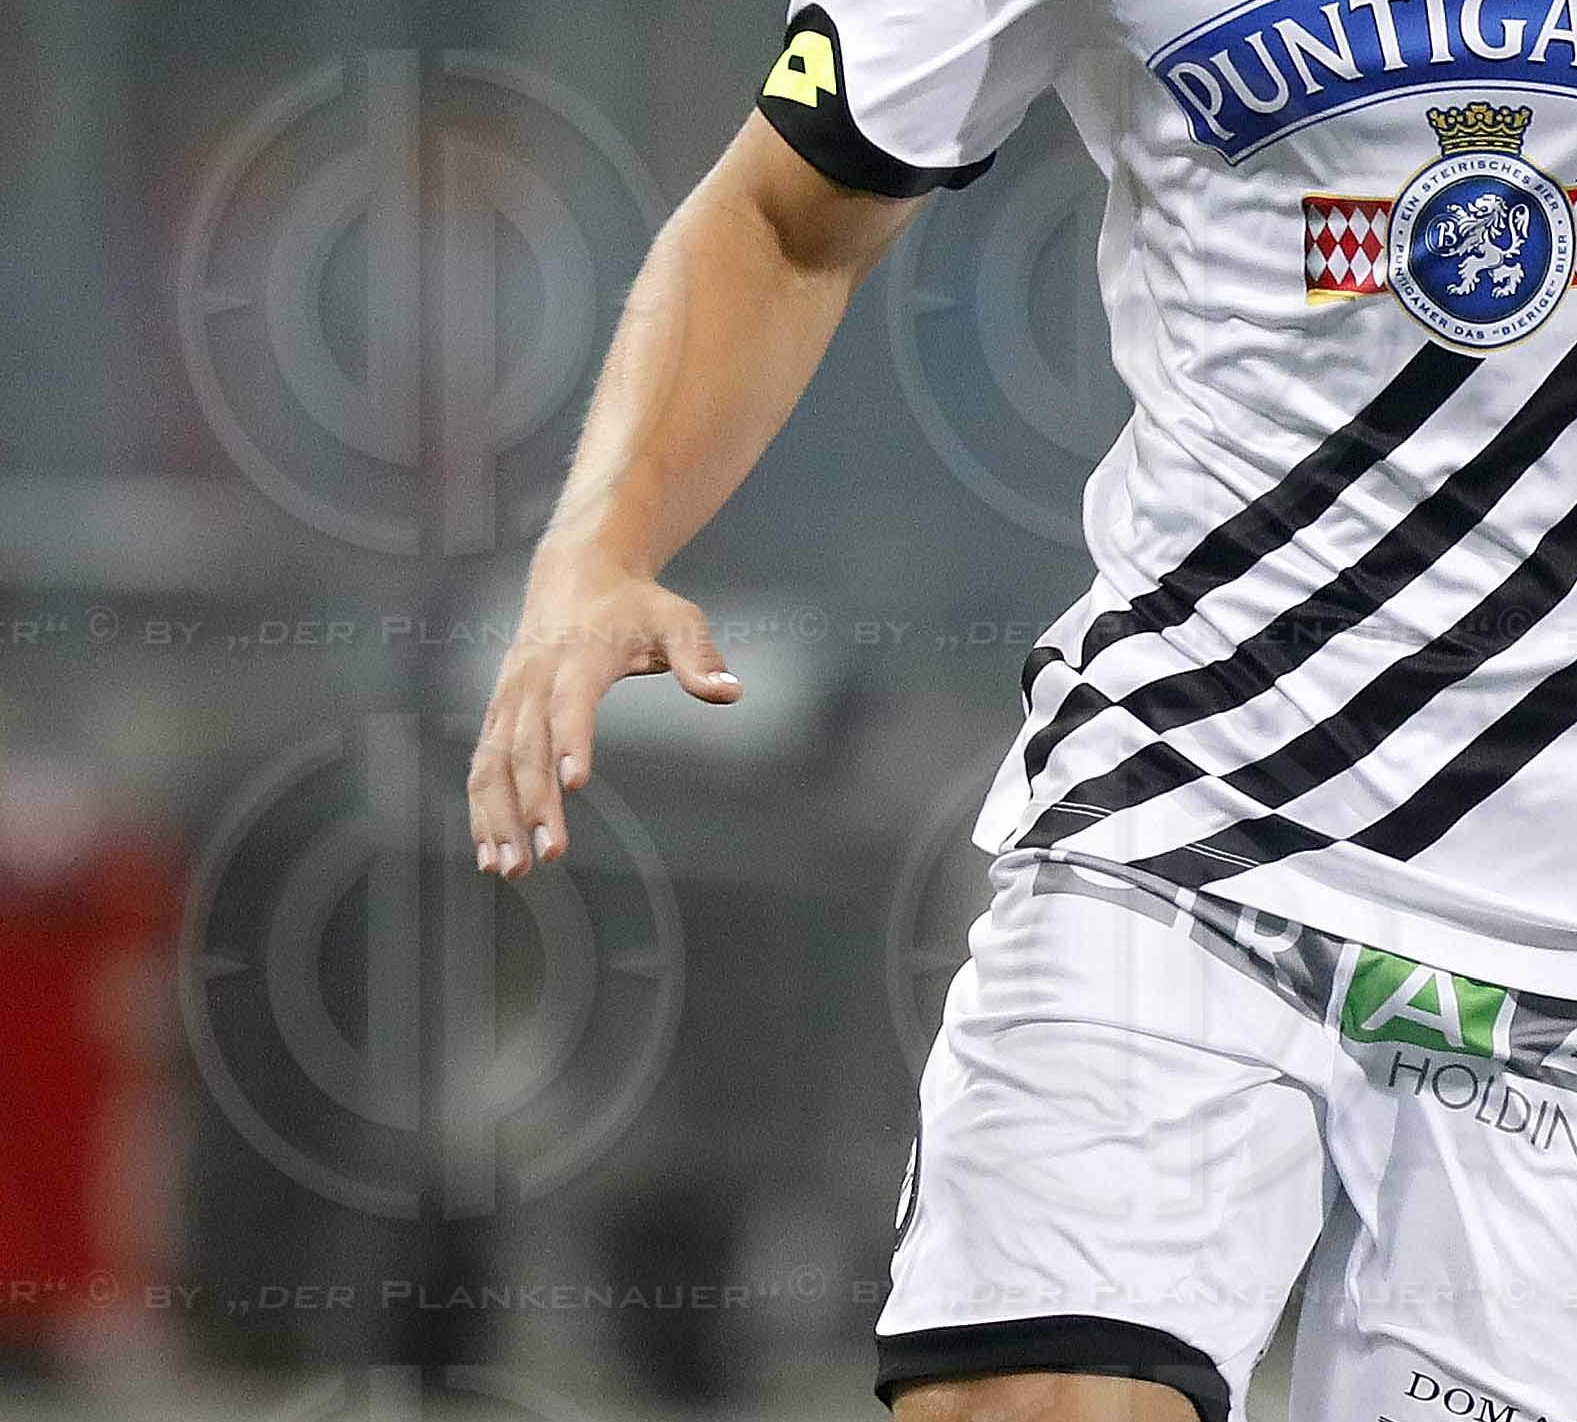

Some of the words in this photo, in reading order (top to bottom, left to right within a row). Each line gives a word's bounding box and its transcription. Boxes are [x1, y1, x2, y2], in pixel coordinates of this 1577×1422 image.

[1401, 196, 1420, 222] EIN
[1421, 159, 1531, 192] STEIRISCHES
[1454, 325, 1485, 340] DAS
[1555, 233, 1568, 274] BIER
